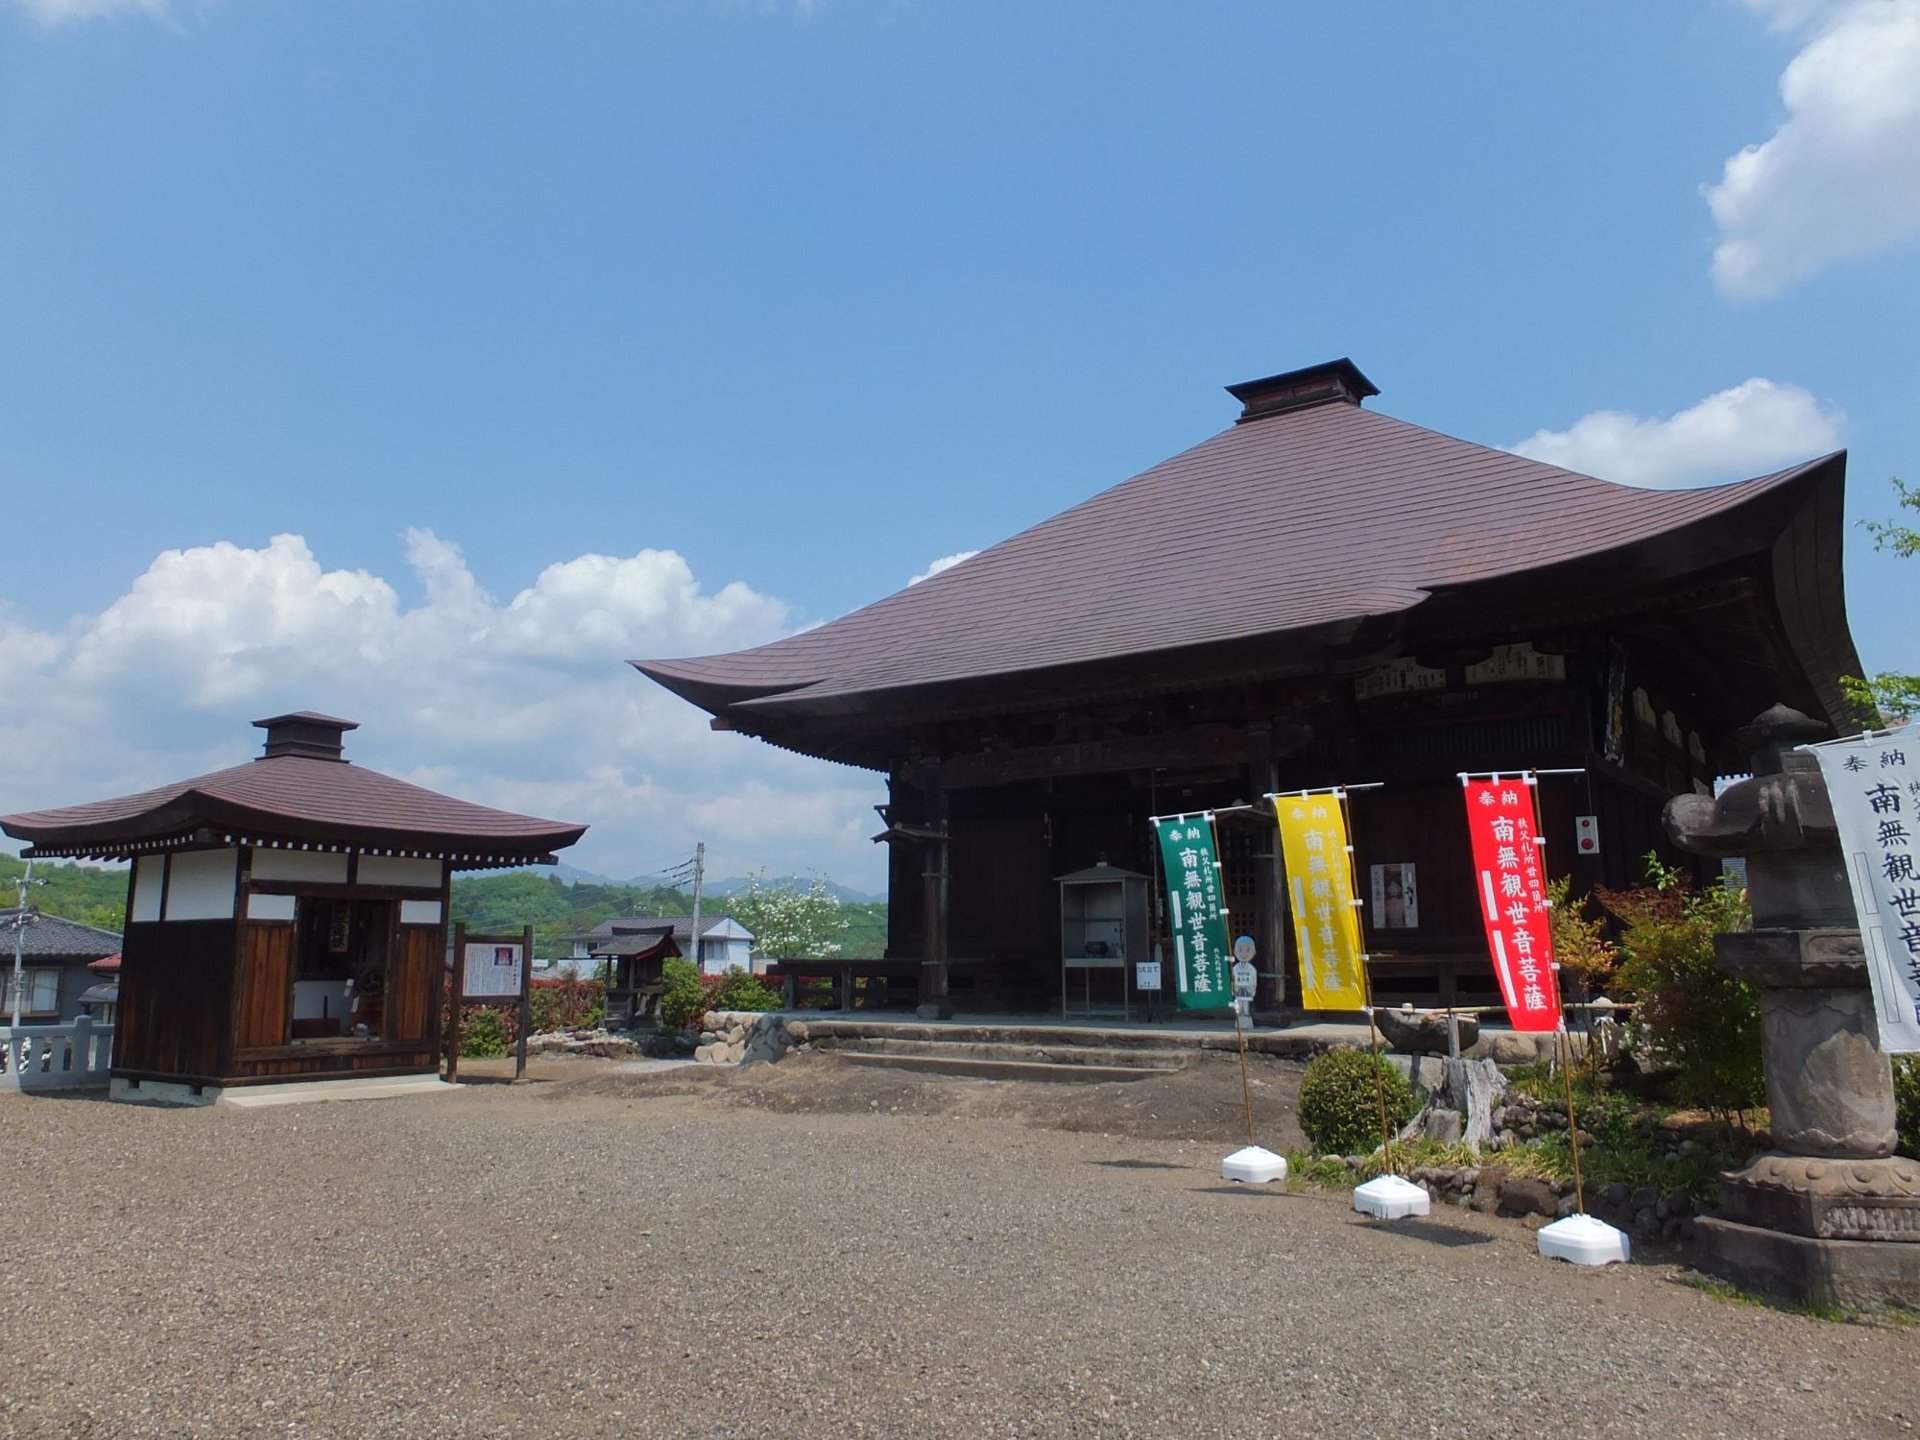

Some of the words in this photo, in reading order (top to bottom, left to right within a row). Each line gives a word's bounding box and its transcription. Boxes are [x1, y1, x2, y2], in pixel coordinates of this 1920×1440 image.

[1179, 847, 1212, 993] 南無観世音菩薩
[1490, 816, 1548, 1010] 南無観世音菩薩
[1865, 782, 1920, 1026] 南無観世音
